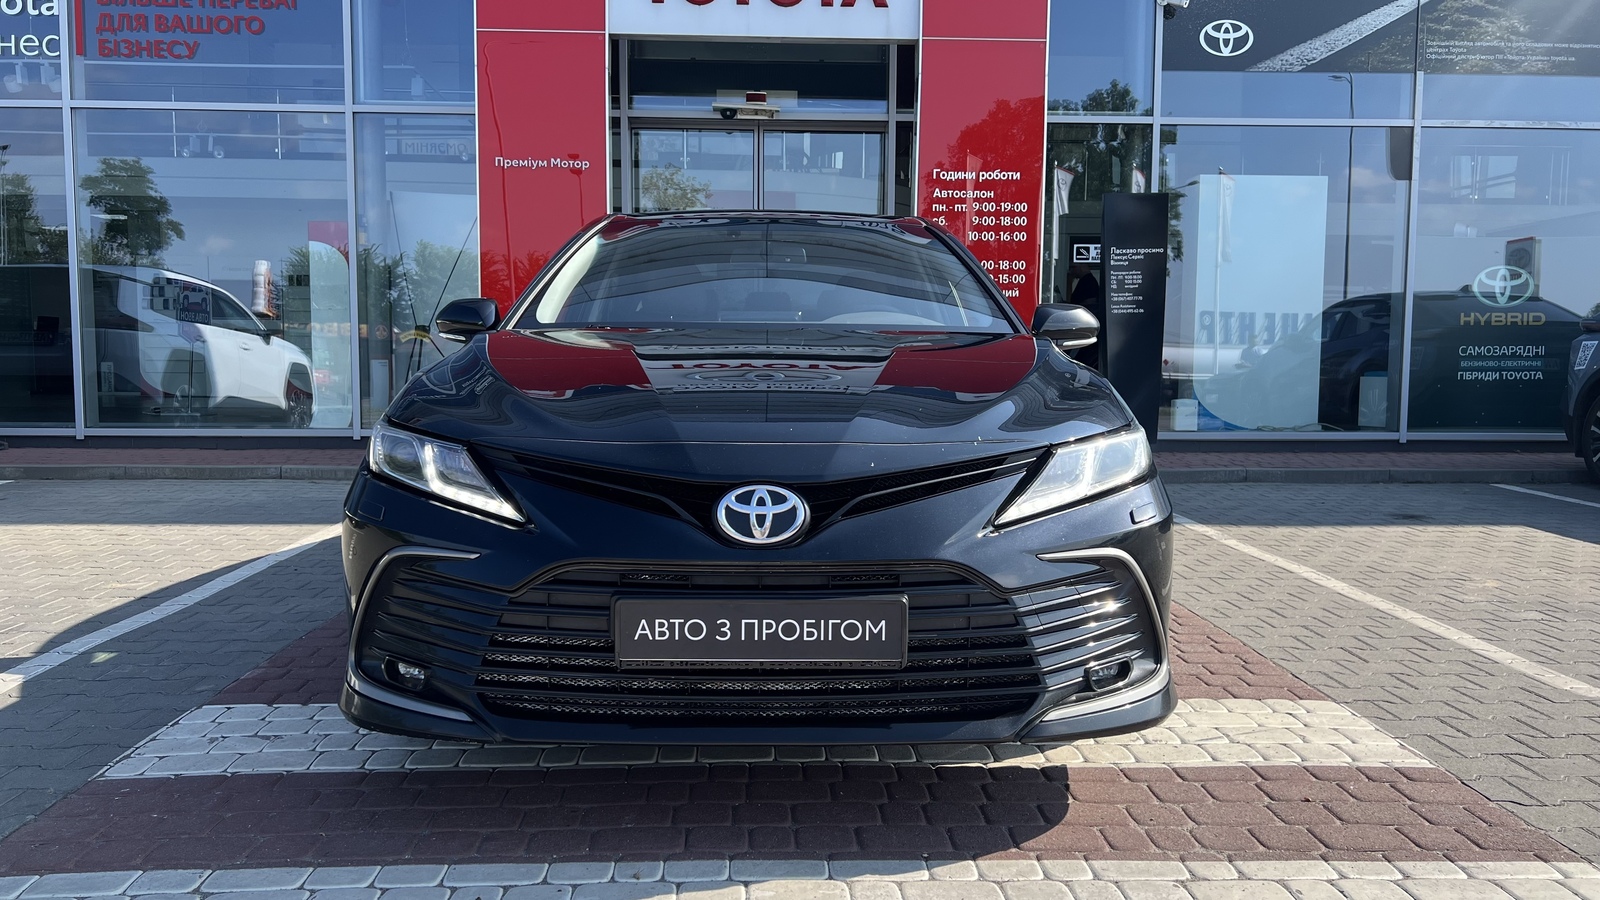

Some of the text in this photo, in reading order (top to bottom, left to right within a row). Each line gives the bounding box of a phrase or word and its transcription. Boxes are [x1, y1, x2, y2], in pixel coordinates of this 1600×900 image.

[96, 12, 265, 35] ДЛЯ ВАШОГО
[97, 38, 199, 59] БІЗНЕСУ
[405, 142, 467, 155] МІНЯЄМО
[495, 156, 590, 170] Преміум Мотор
[933, 168, 1021, 183] Години роботи
[933, 188, 994, 198] Автосалон
[972, 216, 1027, 226] 9:00-18:00
[968, 231, 1027, 241] 10:00-16:00
[1460, 312, 1546, 325] HYBRID
[1459, 345, 1545, 357] САМОЗАРЯДНІ
[1458, 371, 1544, 381] ГІБРИДИ TOYOTA
[634, 618, 886, 641] АВТО З ПРОБІГОМ
